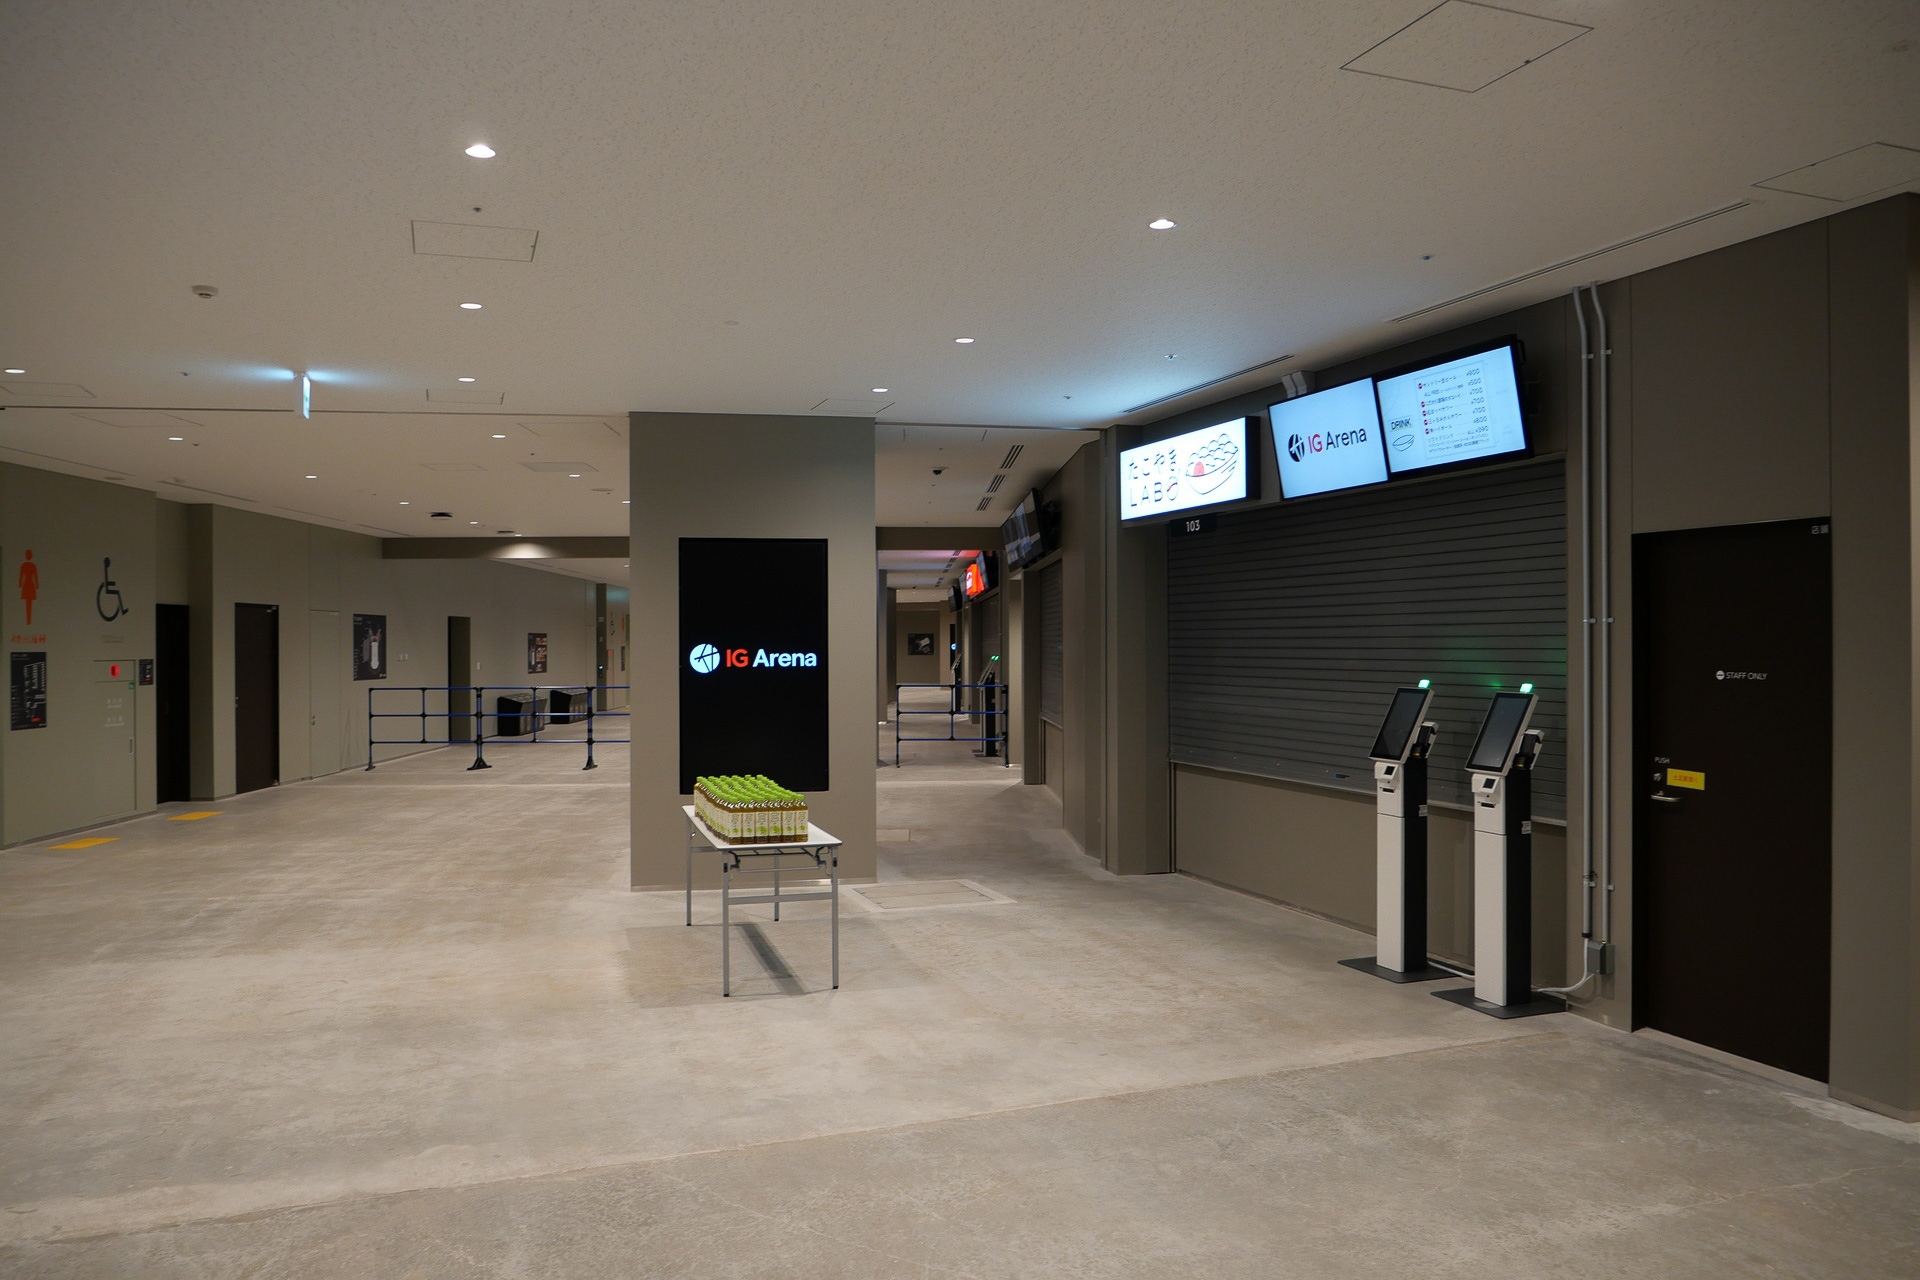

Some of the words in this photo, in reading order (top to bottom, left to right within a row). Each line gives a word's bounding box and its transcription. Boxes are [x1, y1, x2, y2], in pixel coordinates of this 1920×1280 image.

[1390, 418, 1412, 430] DRINK
[1308, 433, 1323, 454] IG
[1325, 428, 1368, 451] Arena
[1128, 448, 1177, 480] たこやき
[1186, 519, 1201, 532] 103
[725, 648, 749, 668] IG
[752, 648, 817, 668] Arena
[1726, 671, 1747, 680] STAFF
[1747, 672, 1769, 681] ONLY
[1654, 756, 1671, 764] PUSH
